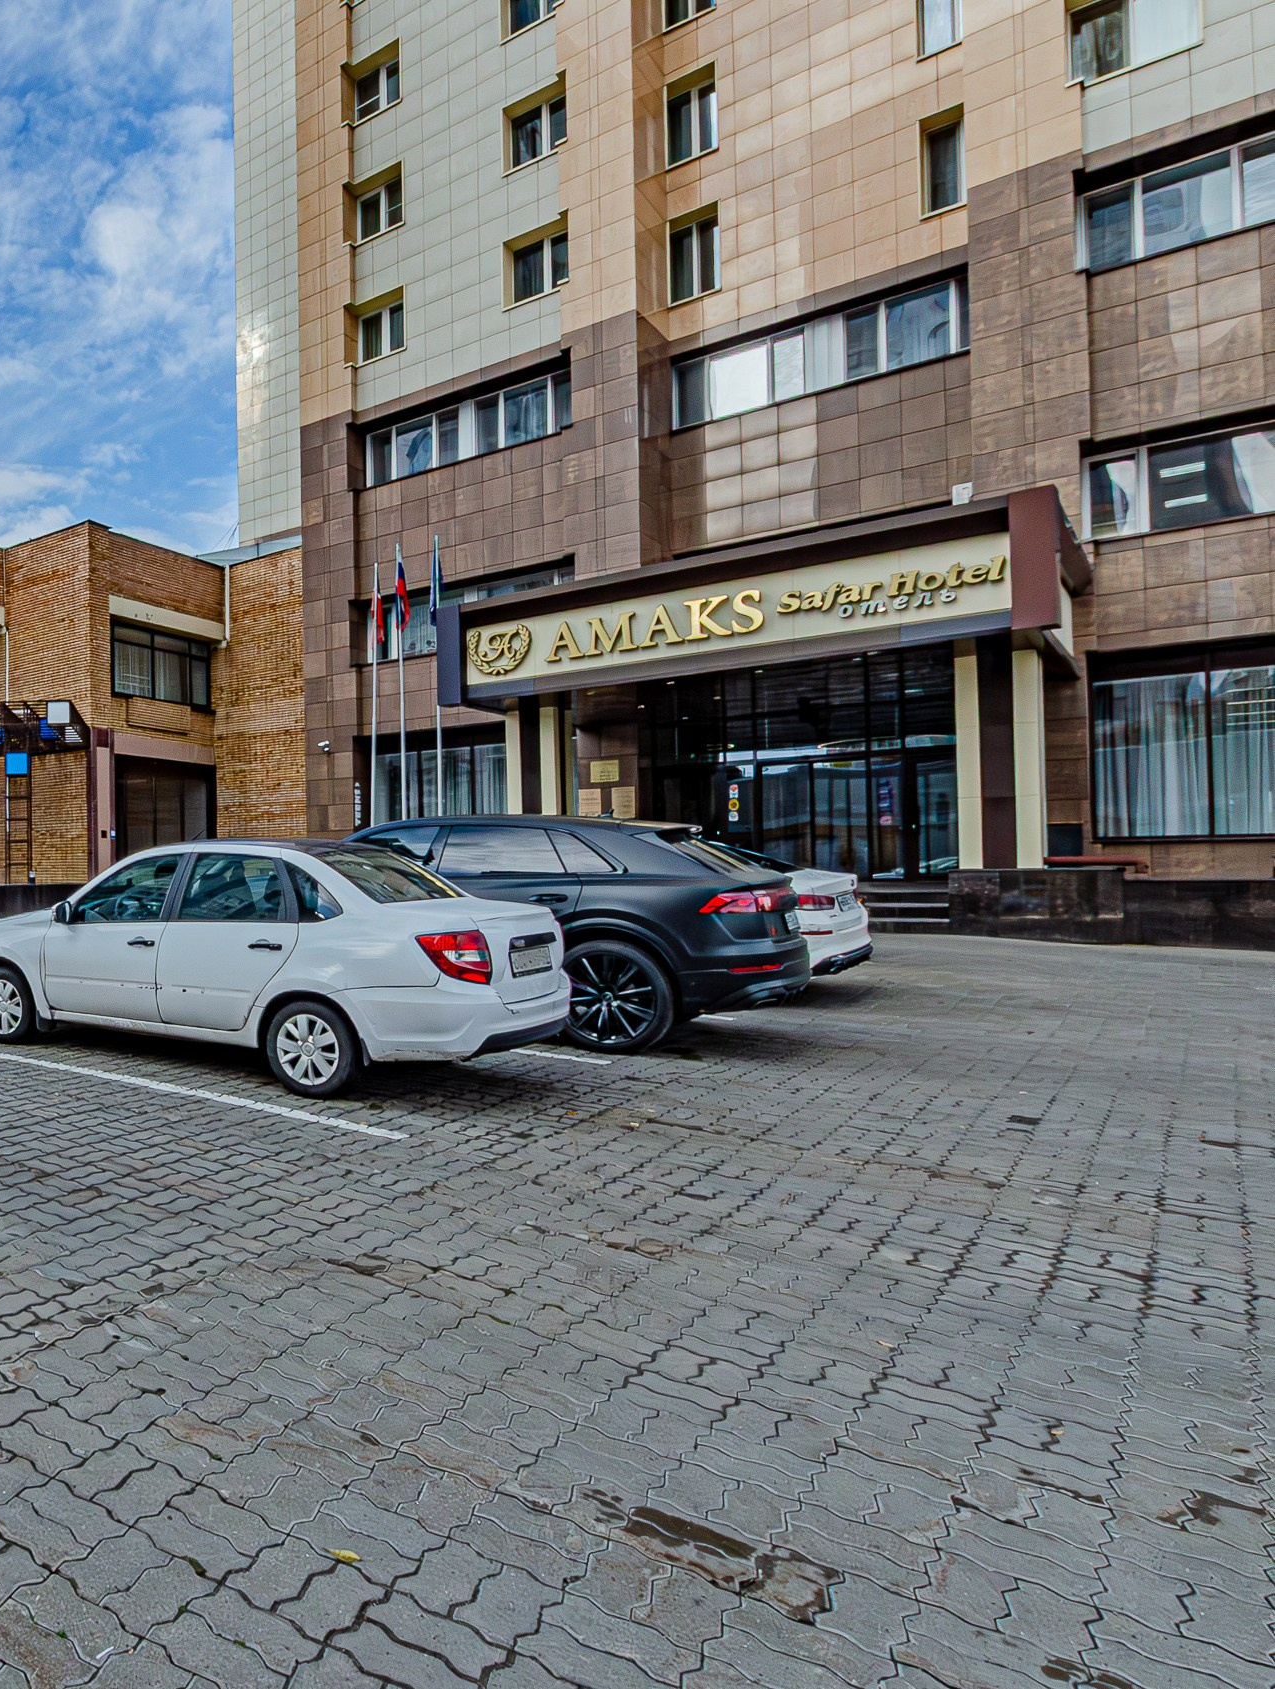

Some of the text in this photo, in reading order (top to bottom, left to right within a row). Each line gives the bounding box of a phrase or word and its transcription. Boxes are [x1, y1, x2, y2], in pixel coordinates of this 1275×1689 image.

[776, 554, 1007, 614] Safar Hotel
[837, 587, 958, 619] отель
[544, 589, 765, 664] AMAKS
